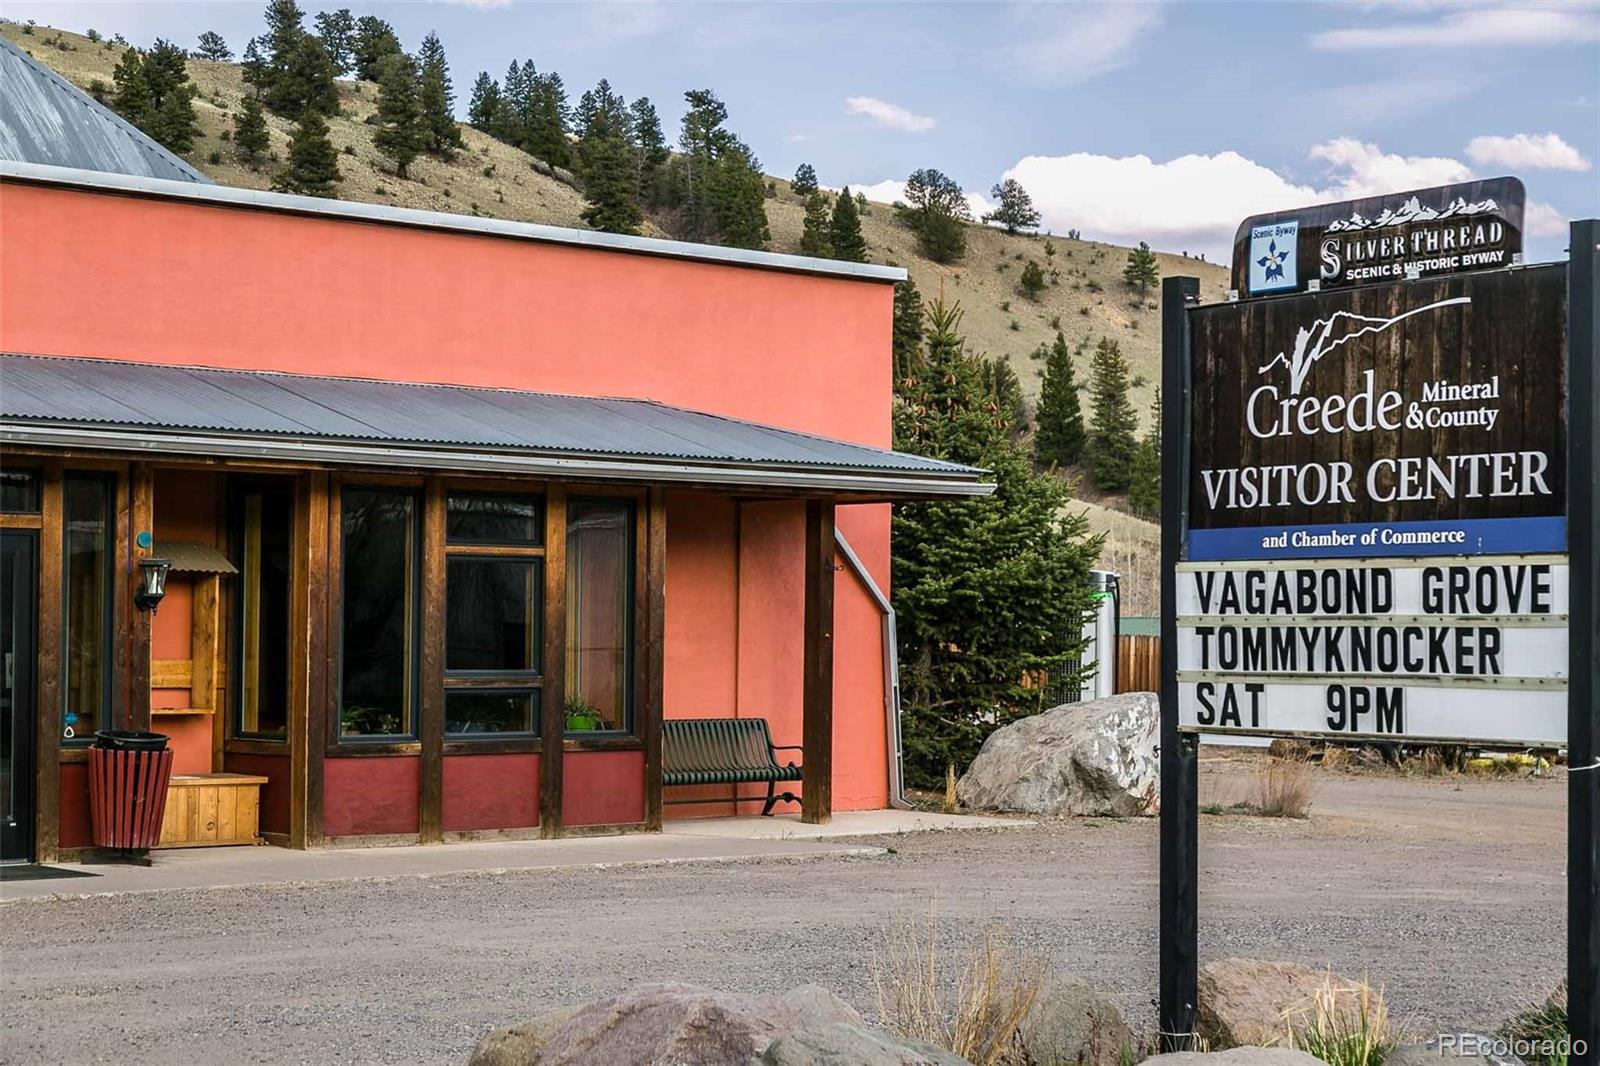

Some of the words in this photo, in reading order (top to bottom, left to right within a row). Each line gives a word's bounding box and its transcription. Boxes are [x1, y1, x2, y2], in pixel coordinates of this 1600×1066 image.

[1252, 227, 1274, 240] Scenic
[1275, 225, 1296, 238] Byway
[1320, 236, 1405, 280] SILVER
[1411, 221, 1503, 253] THREAD
[1346, 267, 1391, 280] SCENIC
[1392, 263, 1402, 275] &
[1463, 250, 1505, 267] BYWAY
[1247, 370, 1402, 439] Creede
[1422, 376, 1499, 403] Mineral
[1202, 462, 1356, 510] VISITOR
[1366, 451, 1552, 502] CENTER
[1262, 533, 1288, 549] and
[1291, 531, 1356, 548] Chamber
[1361, 529, 1377, 546] of
[1381, 528, 1466, 545] Commerce
[1196, 568, 1392, 615] VAGABOND
[1422, 565, 1551, 614] GROVE
[1196, 626, 1501, 675] TOMMYKNOCKER
[1196, 682, 1265, 727] SAT
[1326, 684, 1404, 734] 9PM
